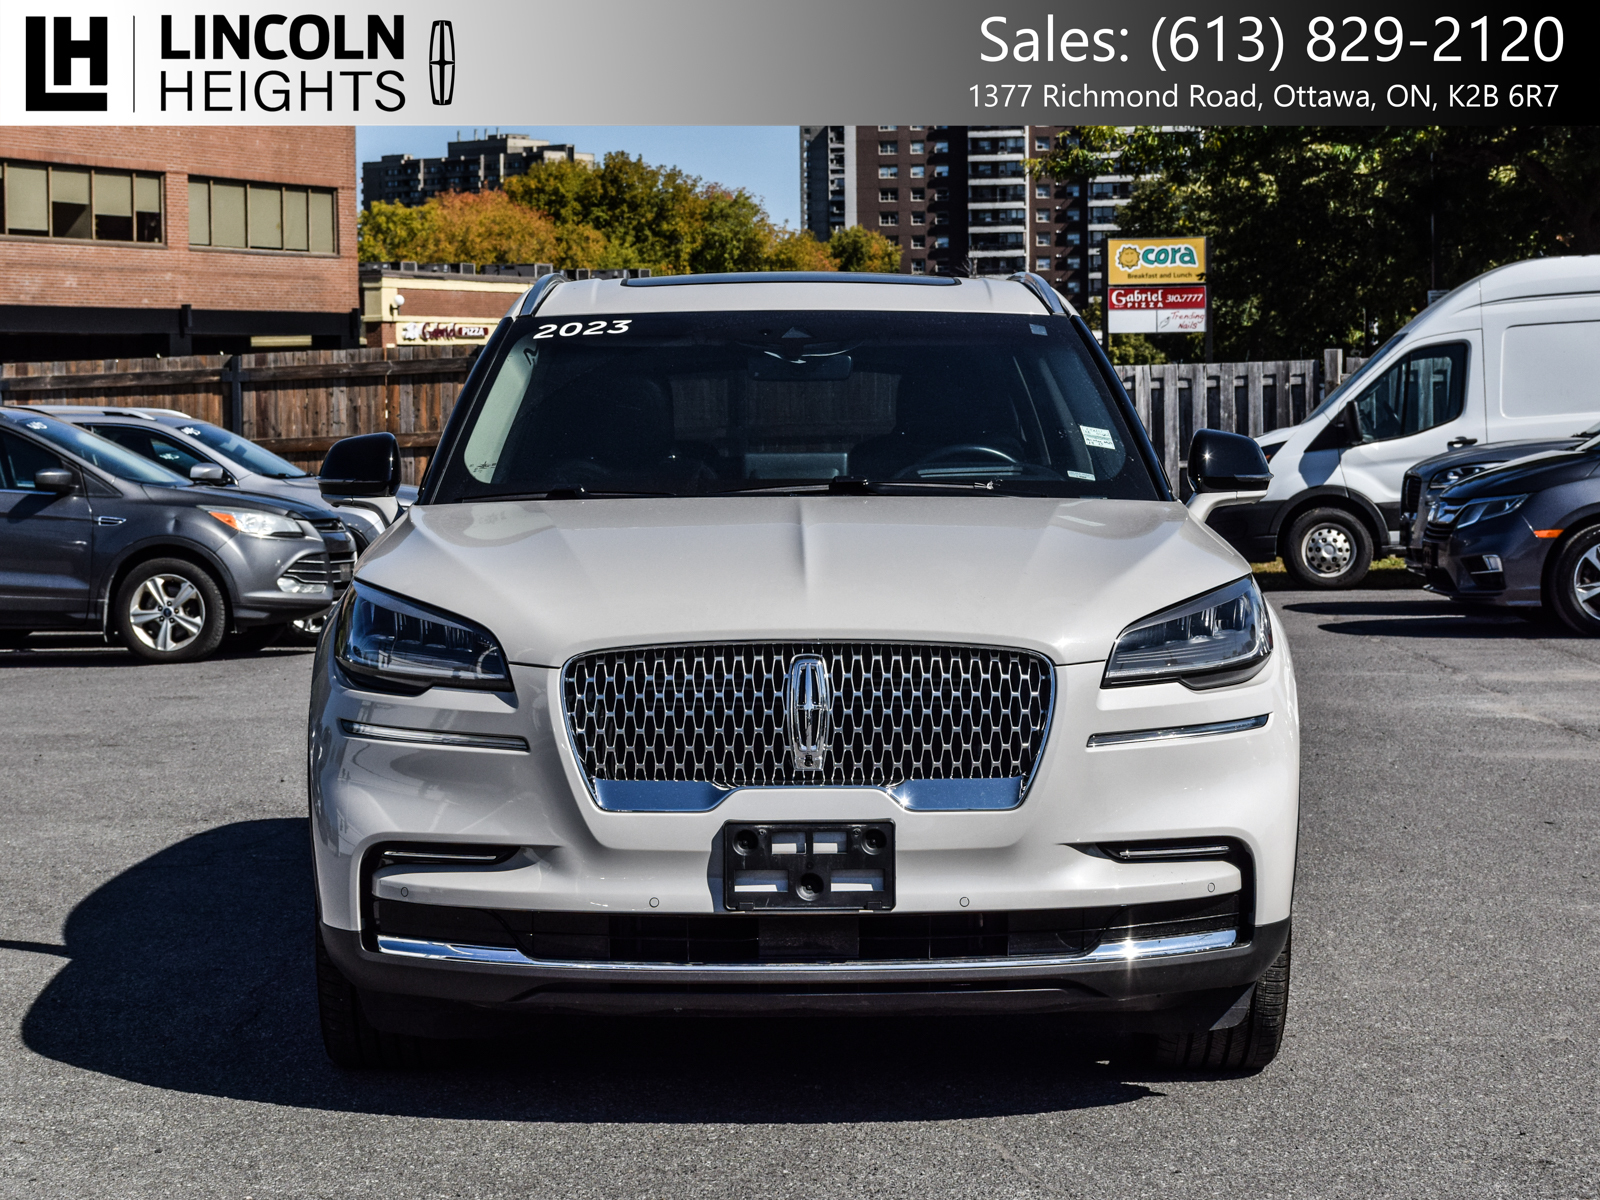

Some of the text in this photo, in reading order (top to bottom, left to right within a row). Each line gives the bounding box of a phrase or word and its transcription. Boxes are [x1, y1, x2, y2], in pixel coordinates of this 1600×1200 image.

[1141, 246, 1197, 265] cora
[1111, 289, 1164, 306] Gabriel
[461, 327, 485, 336] PIZZA
[532, 319, 633, 340] 2023
